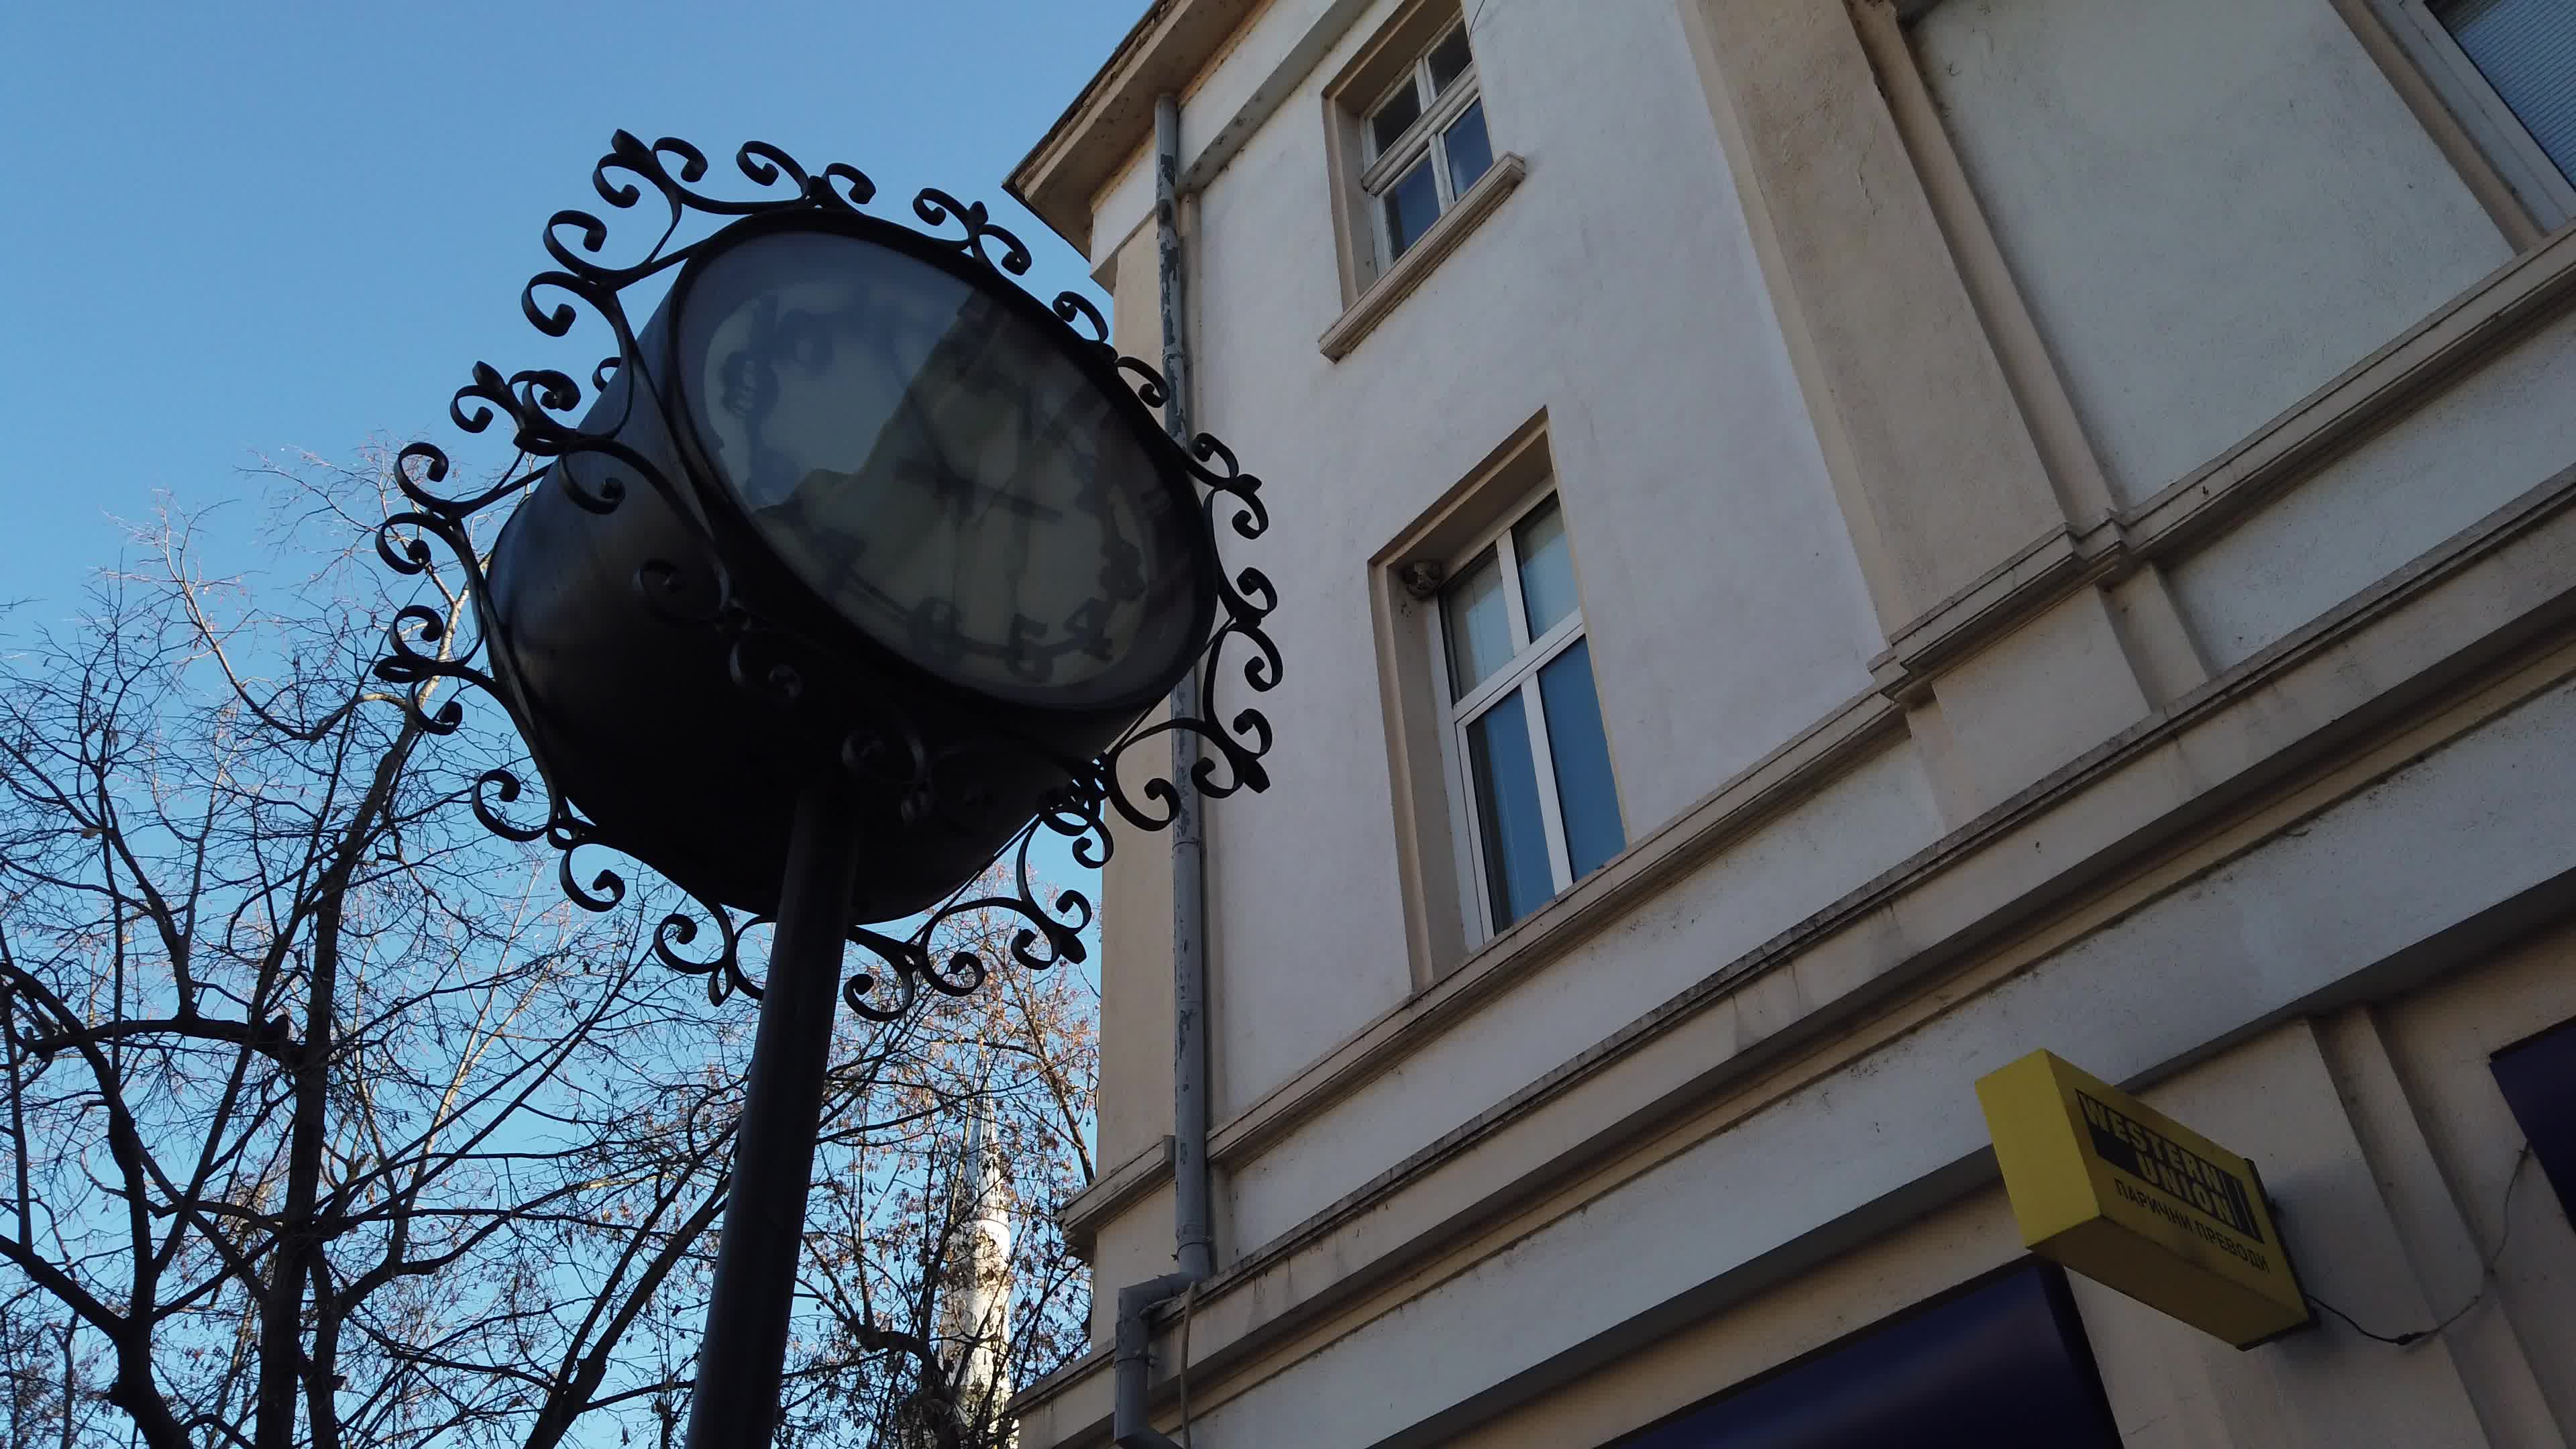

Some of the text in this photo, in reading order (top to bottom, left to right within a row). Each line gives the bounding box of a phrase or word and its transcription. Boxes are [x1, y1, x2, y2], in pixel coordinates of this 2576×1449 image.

[2078, 1091, 2226, 1197] WESTERN
[2136, 1150, 2239, 1229] UNION
[2114, 1177, 2270, 1273] ПАРИЧНИ ПРЕВОДИ
